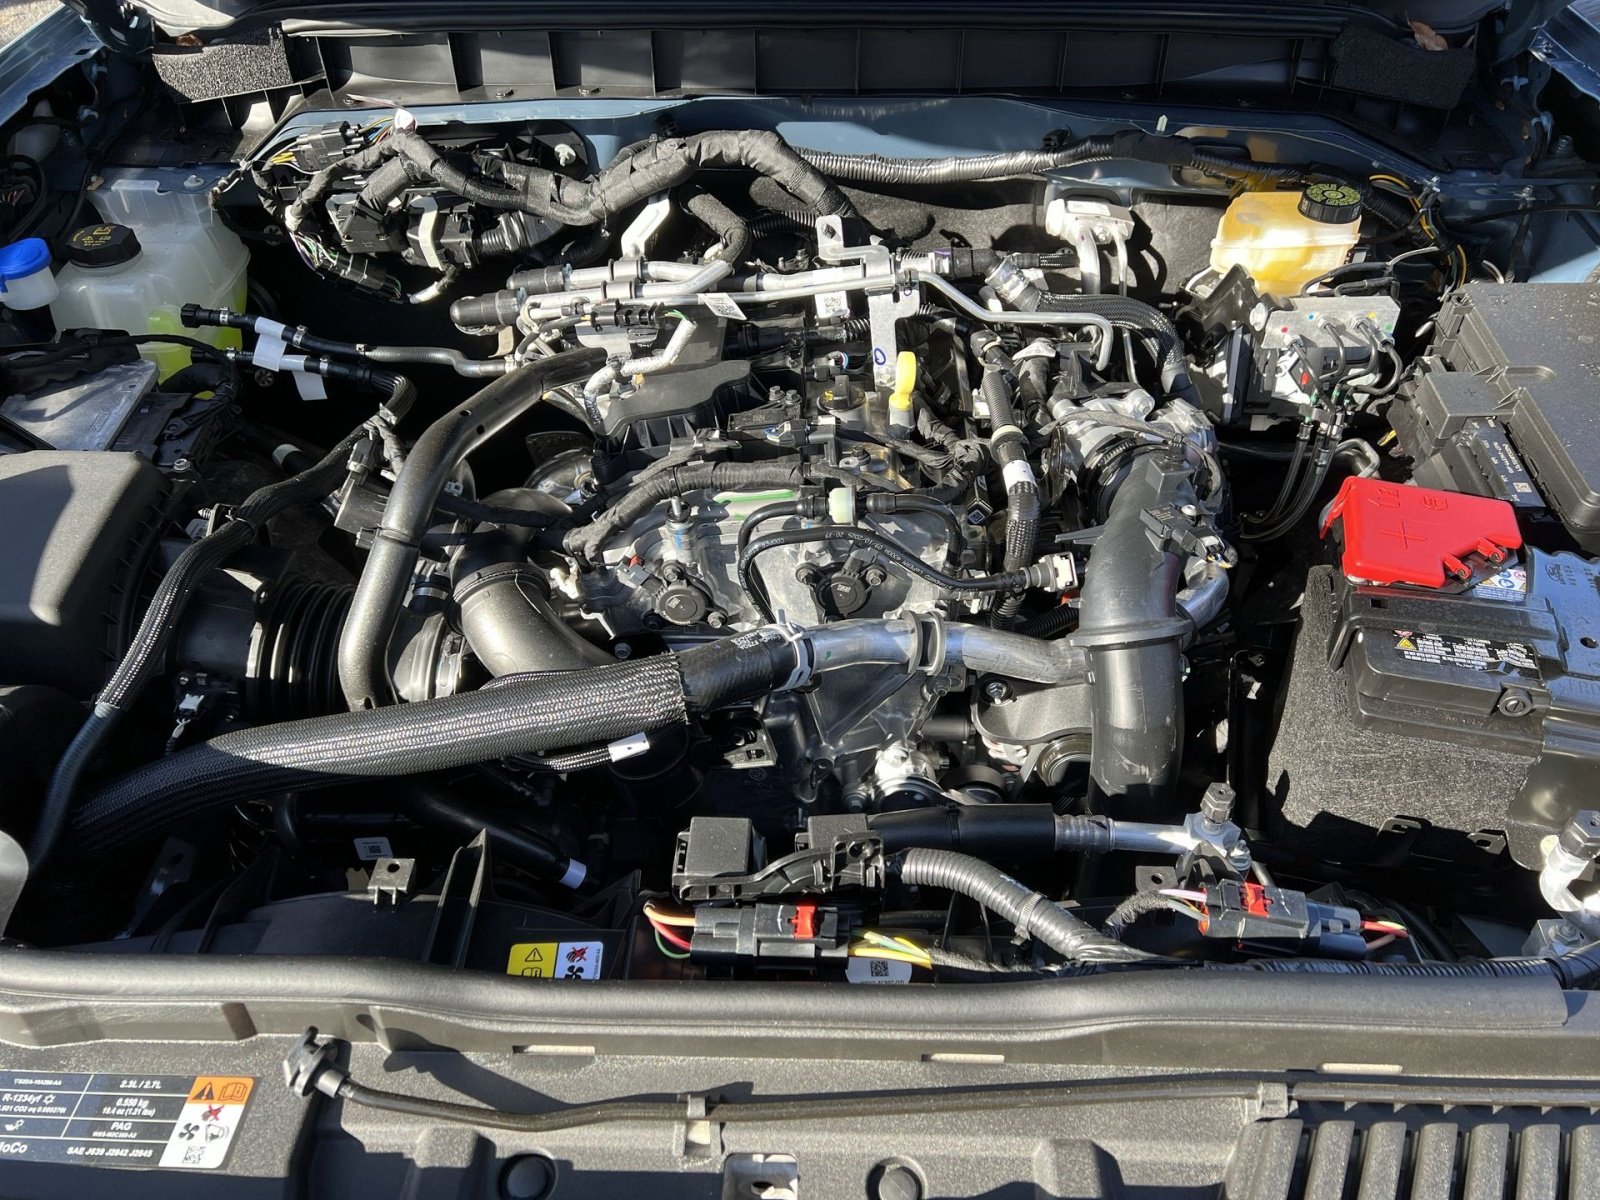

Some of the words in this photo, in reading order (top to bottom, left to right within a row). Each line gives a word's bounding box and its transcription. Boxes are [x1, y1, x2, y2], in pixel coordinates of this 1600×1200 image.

[2, 1093, 43, 1105] R-1234yf
[138, 1098, 149, 1109] kg
[110, 1121, 132, 1131] PAG
[66, 1146, 84, 1155] SAE
